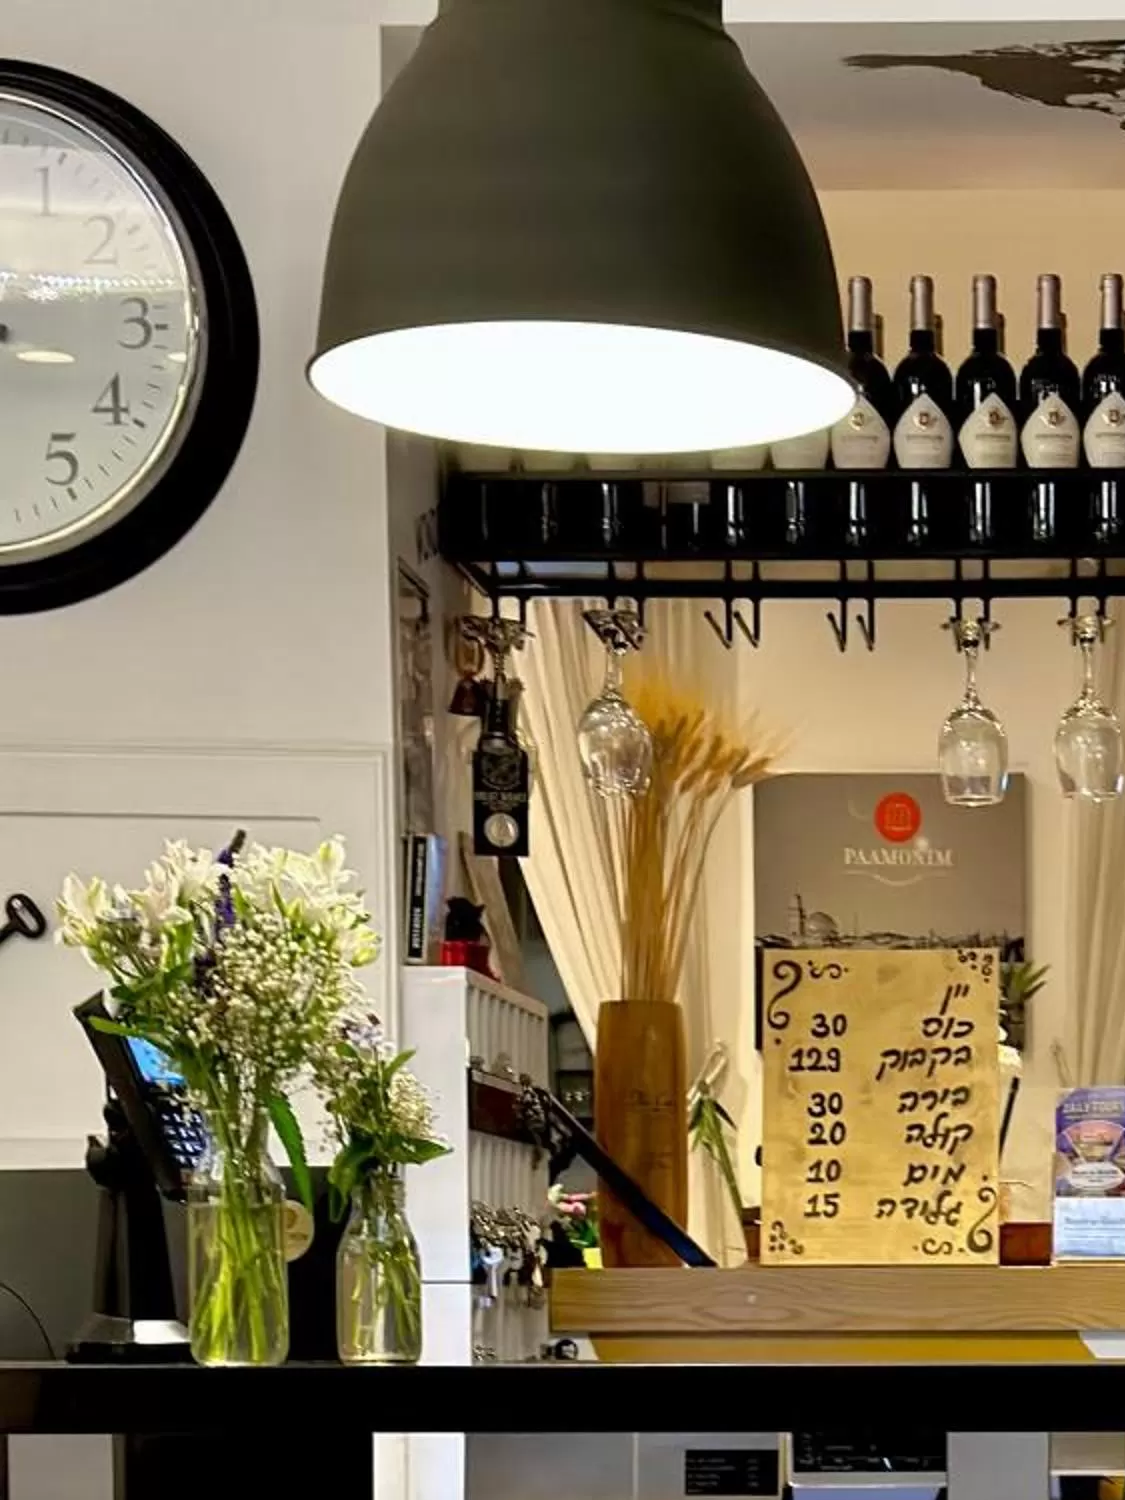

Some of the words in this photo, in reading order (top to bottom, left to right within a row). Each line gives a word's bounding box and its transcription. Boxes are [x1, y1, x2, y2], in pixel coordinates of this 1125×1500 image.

[34, 167, 58, 217] 1
[82, 214, 118, 265] 2
[118, 297, 152, 349] 3
[91, 372, 131, 426] 4
[45, 432, 79, 486] 5
[844, 847, 954, 866] PAAMONIM
[939, 983, 970, 1016] יין
[810, 1013, 848, 1039] 30
[922, 1017, 975, 1040] כוס
[788, 1047, 841, 1073] 129
[875, 1045, 972, 1082] בקבוק
[807, 1091, 843, 1118] 30
[897, 1086, 971, 1114] בירה
[807, 1121, 846, 1146] 20
[905, 1112, 974, 1156] קולה
[806, 1159, 842, 1183] 10
[903, 1163, 966, 1187] מים
[804, 1193, 840, 1218] 15
[876, 1190, 962, 1226] גלידה
